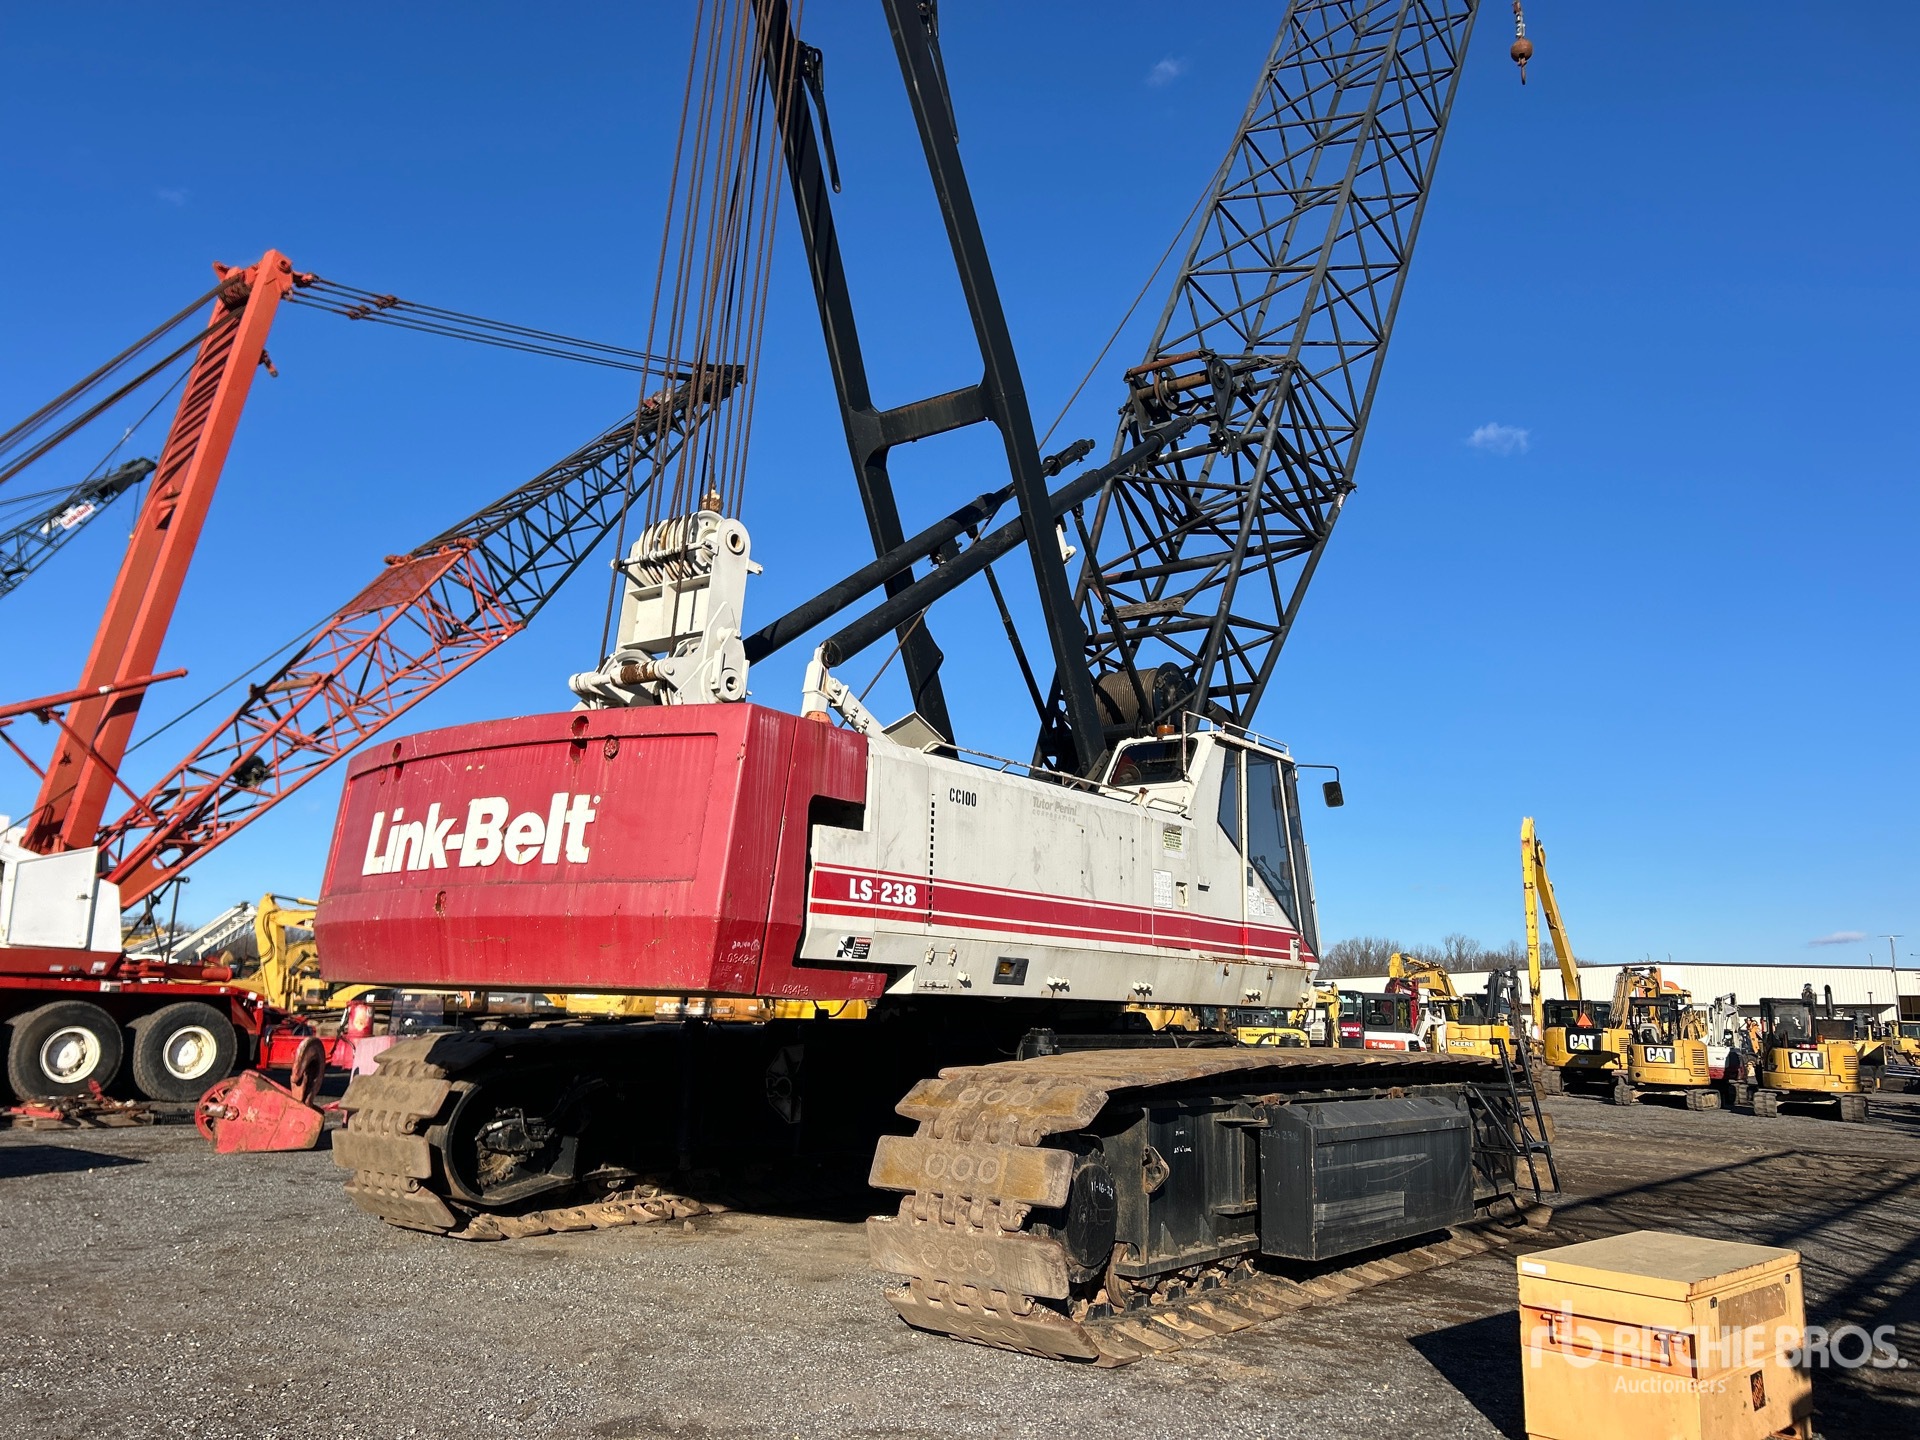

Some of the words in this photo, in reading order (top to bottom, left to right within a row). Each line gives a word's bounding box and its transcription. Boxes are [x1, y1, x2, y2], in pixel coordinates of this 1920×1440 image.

[1032, 796, 1054, 811] Tutor
[1054, 800, 1077, 816] Perini
[362, 792, 597, 876] Link-Belt
[849, 878, 917, 906] LS-238
[1569, 1034, 1596, 1051] CAT
[1646, 1047, 1673, 1063] CAT
[1791, 1052, 1820, 1069] CAT
